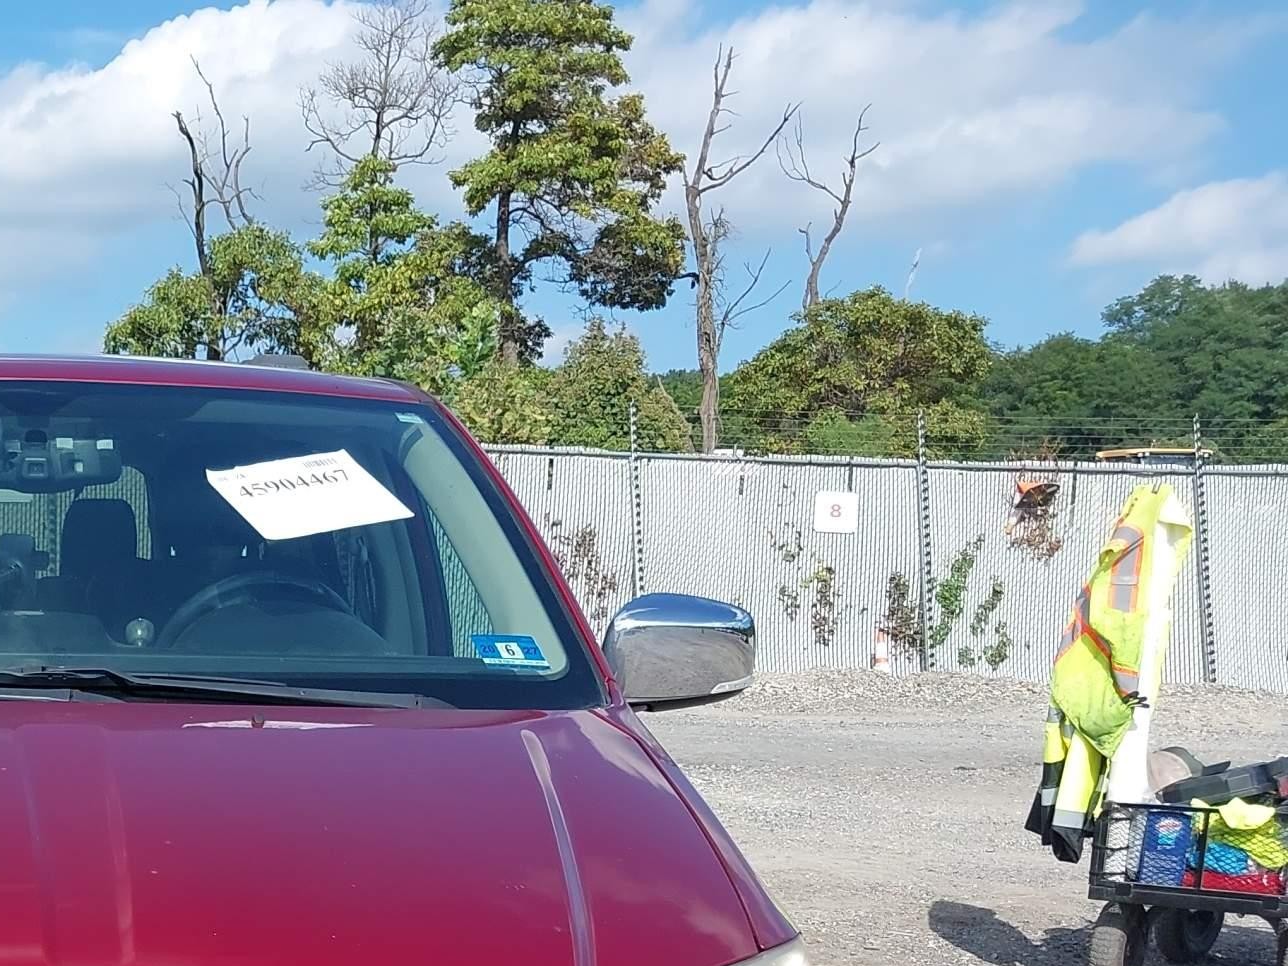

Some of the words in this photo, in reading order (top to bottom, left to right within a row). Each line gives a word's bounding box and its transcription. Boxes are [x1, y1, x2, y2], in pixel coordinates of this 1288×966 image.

[239, 469, 349, 497] 45904467
[830, 503, 841, 518] 8
[504, 643, 516, 657] 6
